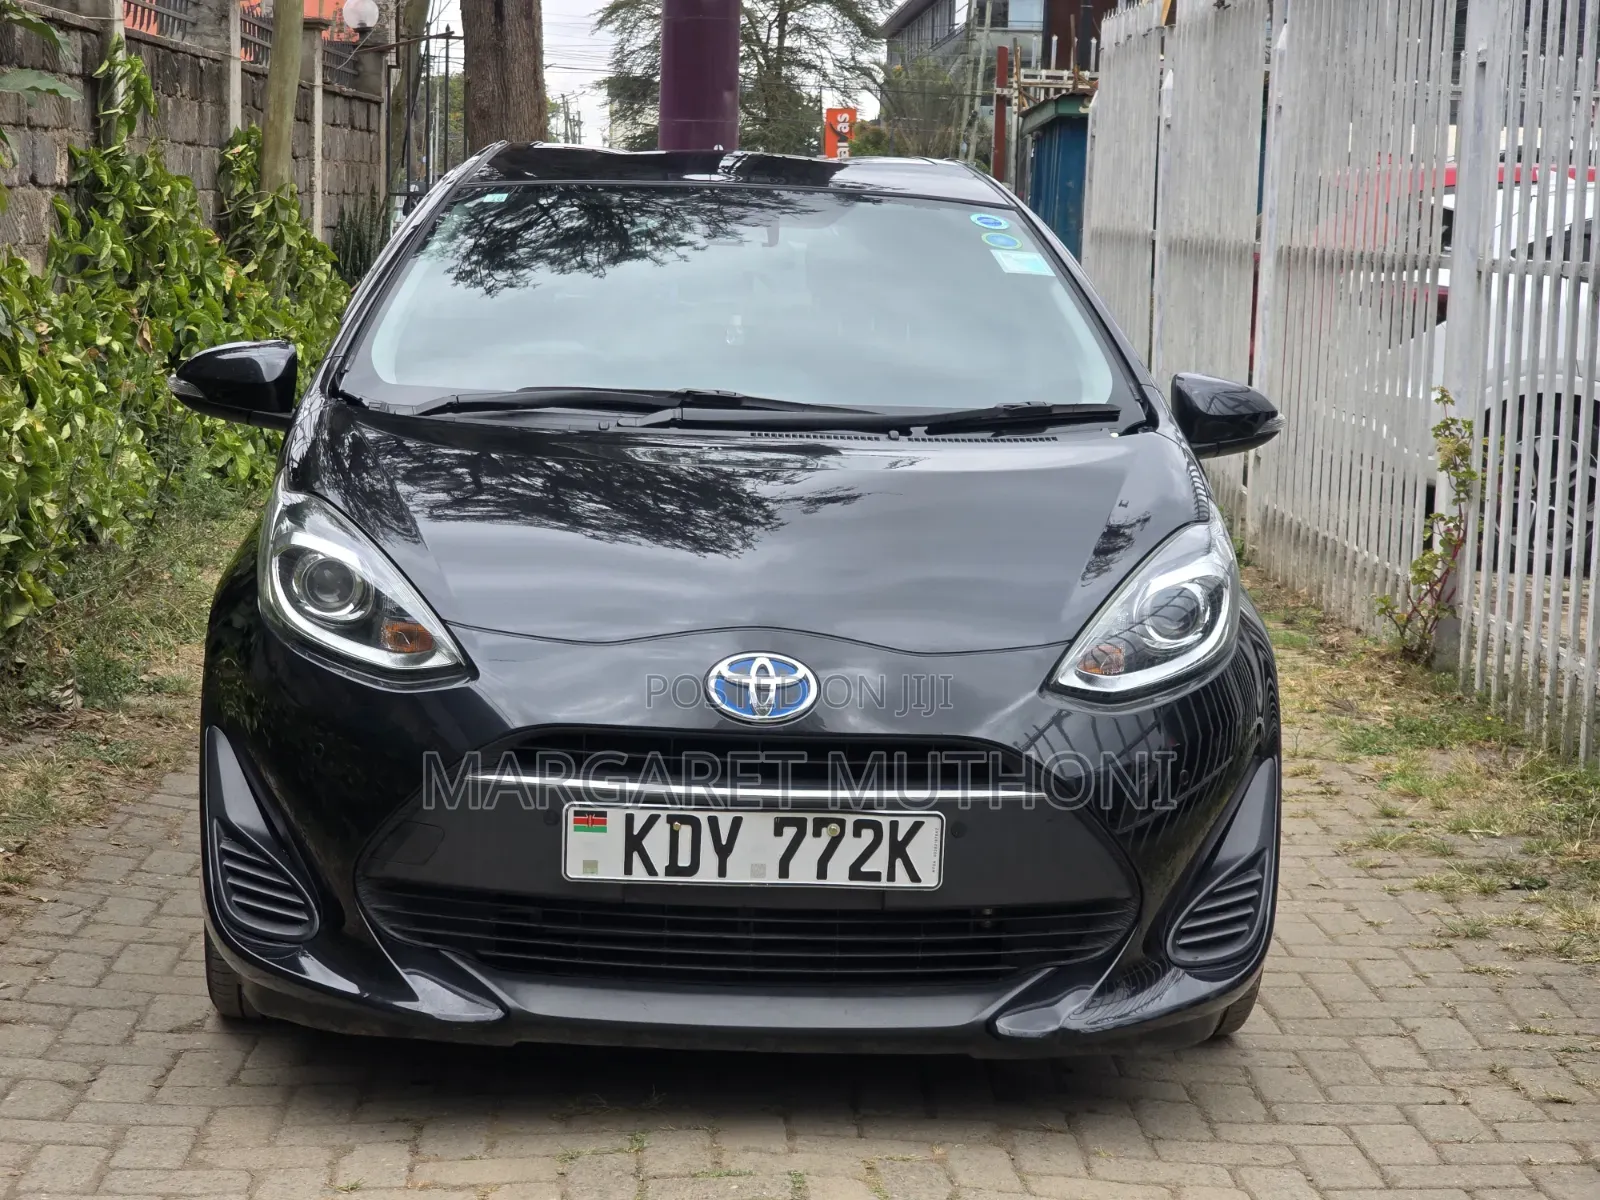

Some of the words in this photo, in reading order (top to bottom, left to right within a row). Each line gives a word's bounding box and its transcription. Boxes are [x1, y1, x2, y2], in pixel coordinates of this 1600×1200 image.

[829, 113, 850, 158] aivas
[623, 812, 744, 878] KDY
[773, 815, 926, 883] 772K
